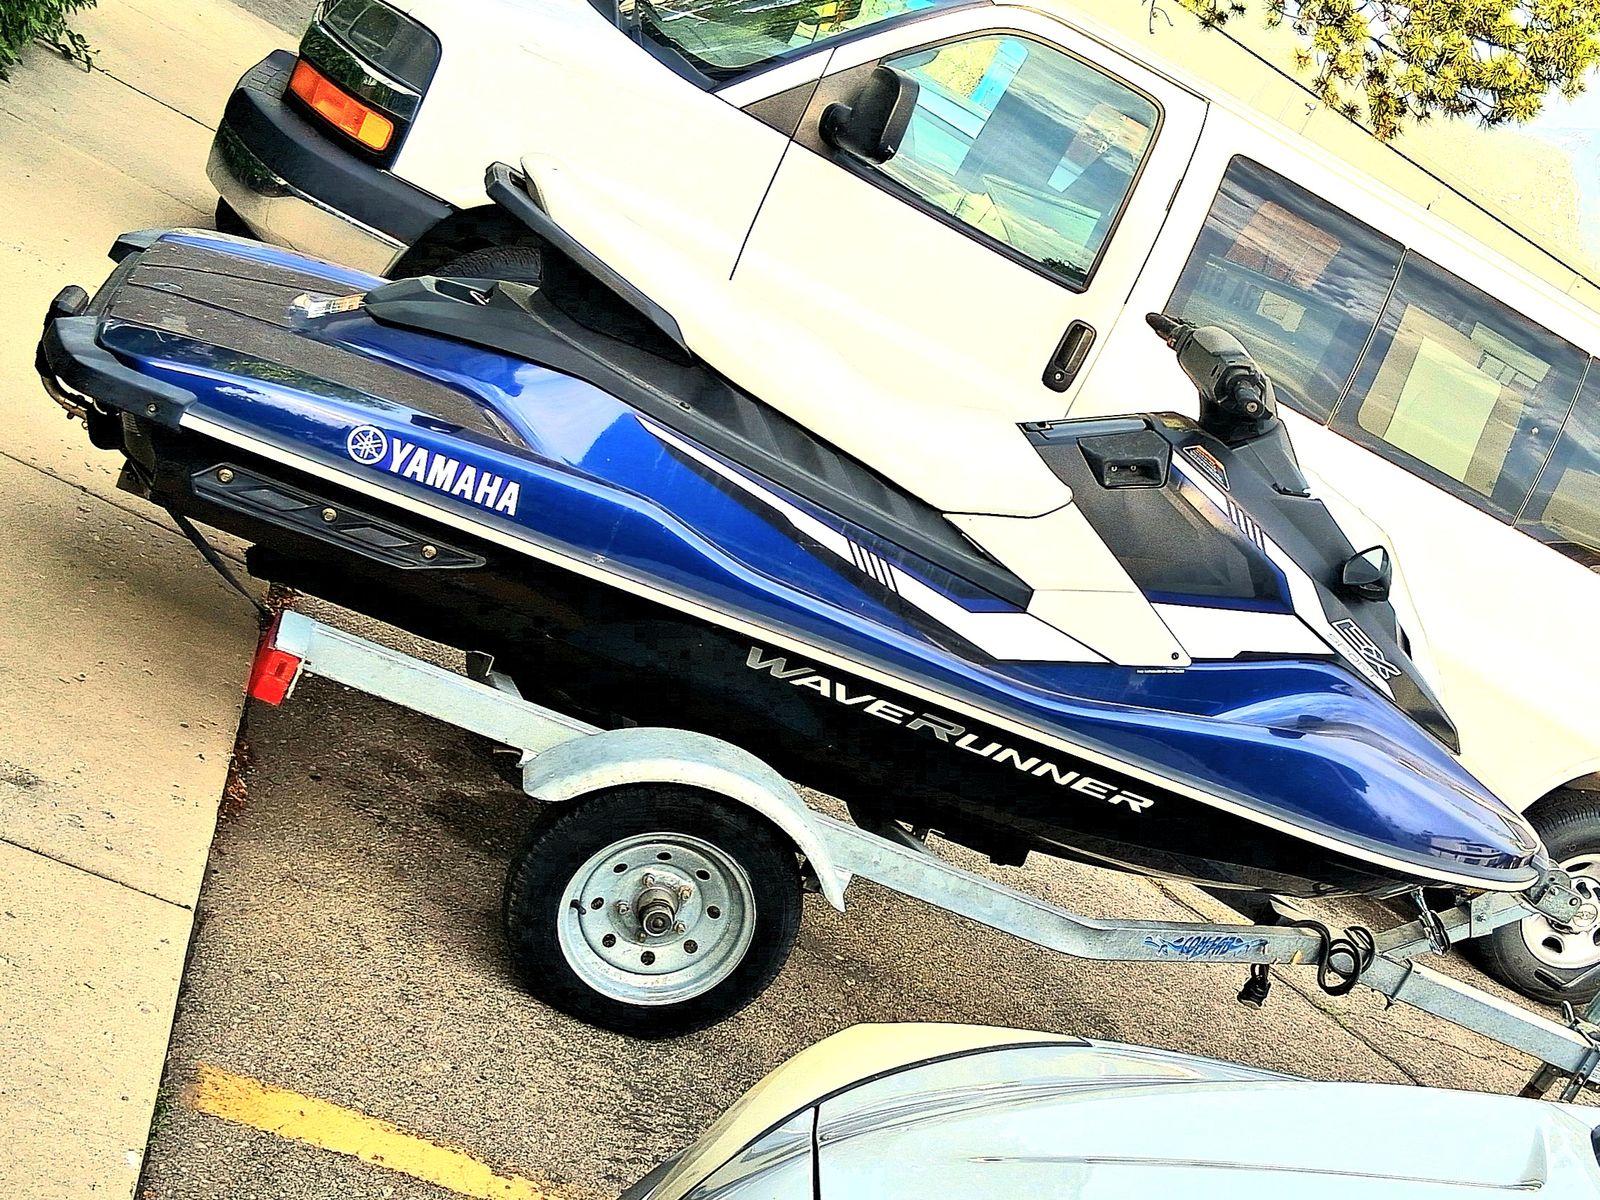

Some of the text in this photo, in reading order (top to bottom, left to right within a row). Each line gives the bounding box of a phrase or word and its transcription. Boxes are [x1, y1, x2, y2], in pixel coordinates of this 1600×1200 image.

[388, 437, 521, 517] YAMAHA
[1330, 617, 1402, 680] EX
[745, 645, 1155, 814] WAVERUNNER
